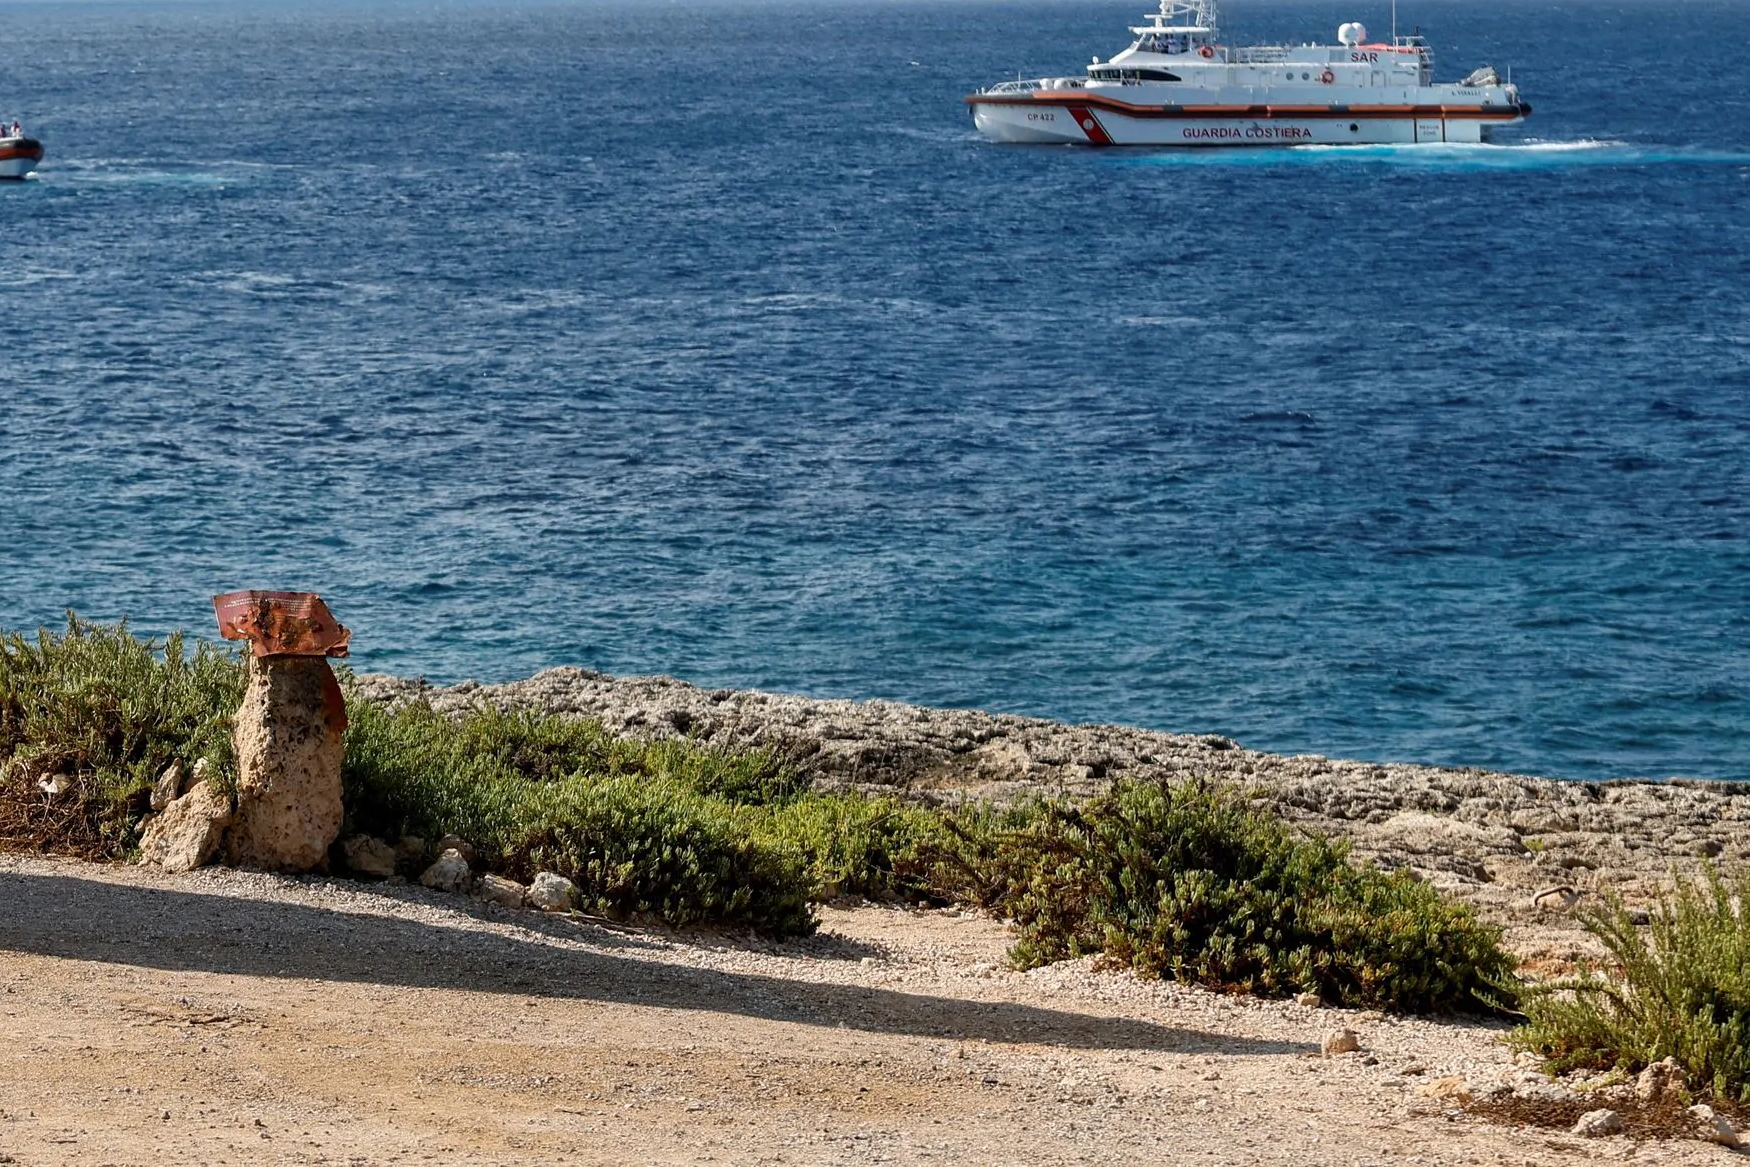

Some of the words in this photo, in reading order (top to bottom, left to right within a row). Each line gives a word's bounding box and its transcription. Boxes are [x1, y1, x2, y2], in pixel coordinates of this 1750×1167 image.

[1350, 52, 1378, 63] SAR
[1027, 113, 1038, 121] CP
[1182, 127, 1242, 138] GUARDIA
[1245, 127, 1312, 138] COSTIERA
